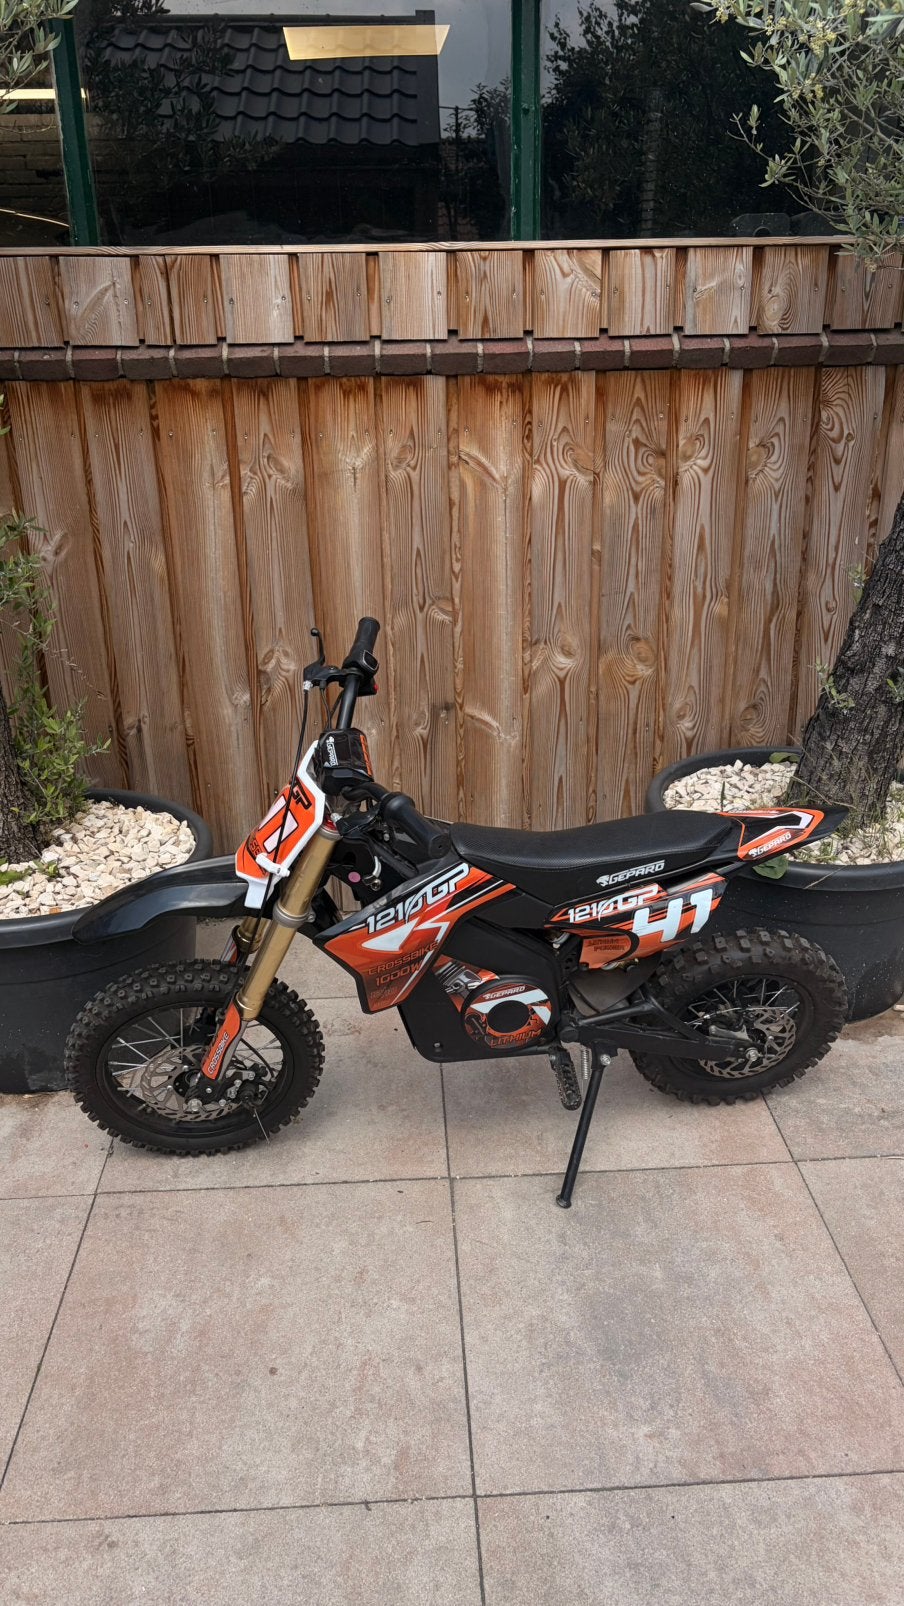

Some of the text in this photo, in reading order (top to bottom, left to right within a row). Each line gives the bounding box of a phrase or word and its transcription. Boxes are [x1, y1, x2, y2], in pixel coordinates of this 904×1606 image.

[757, 831, 792, 855] GEPARD
[608, 859, 666, 885] GEPARD
[632, 888, 713, 943] 41
[368, 941, 440, 975] CROSSBIKE
[375, 961, 424, 986] 1000W
[489, 985, 526, 1000] GEPARD
[490, 1028, 543, 1049] LITHIUM
[207, 1031, 230, 1075] CROSSBIKE
